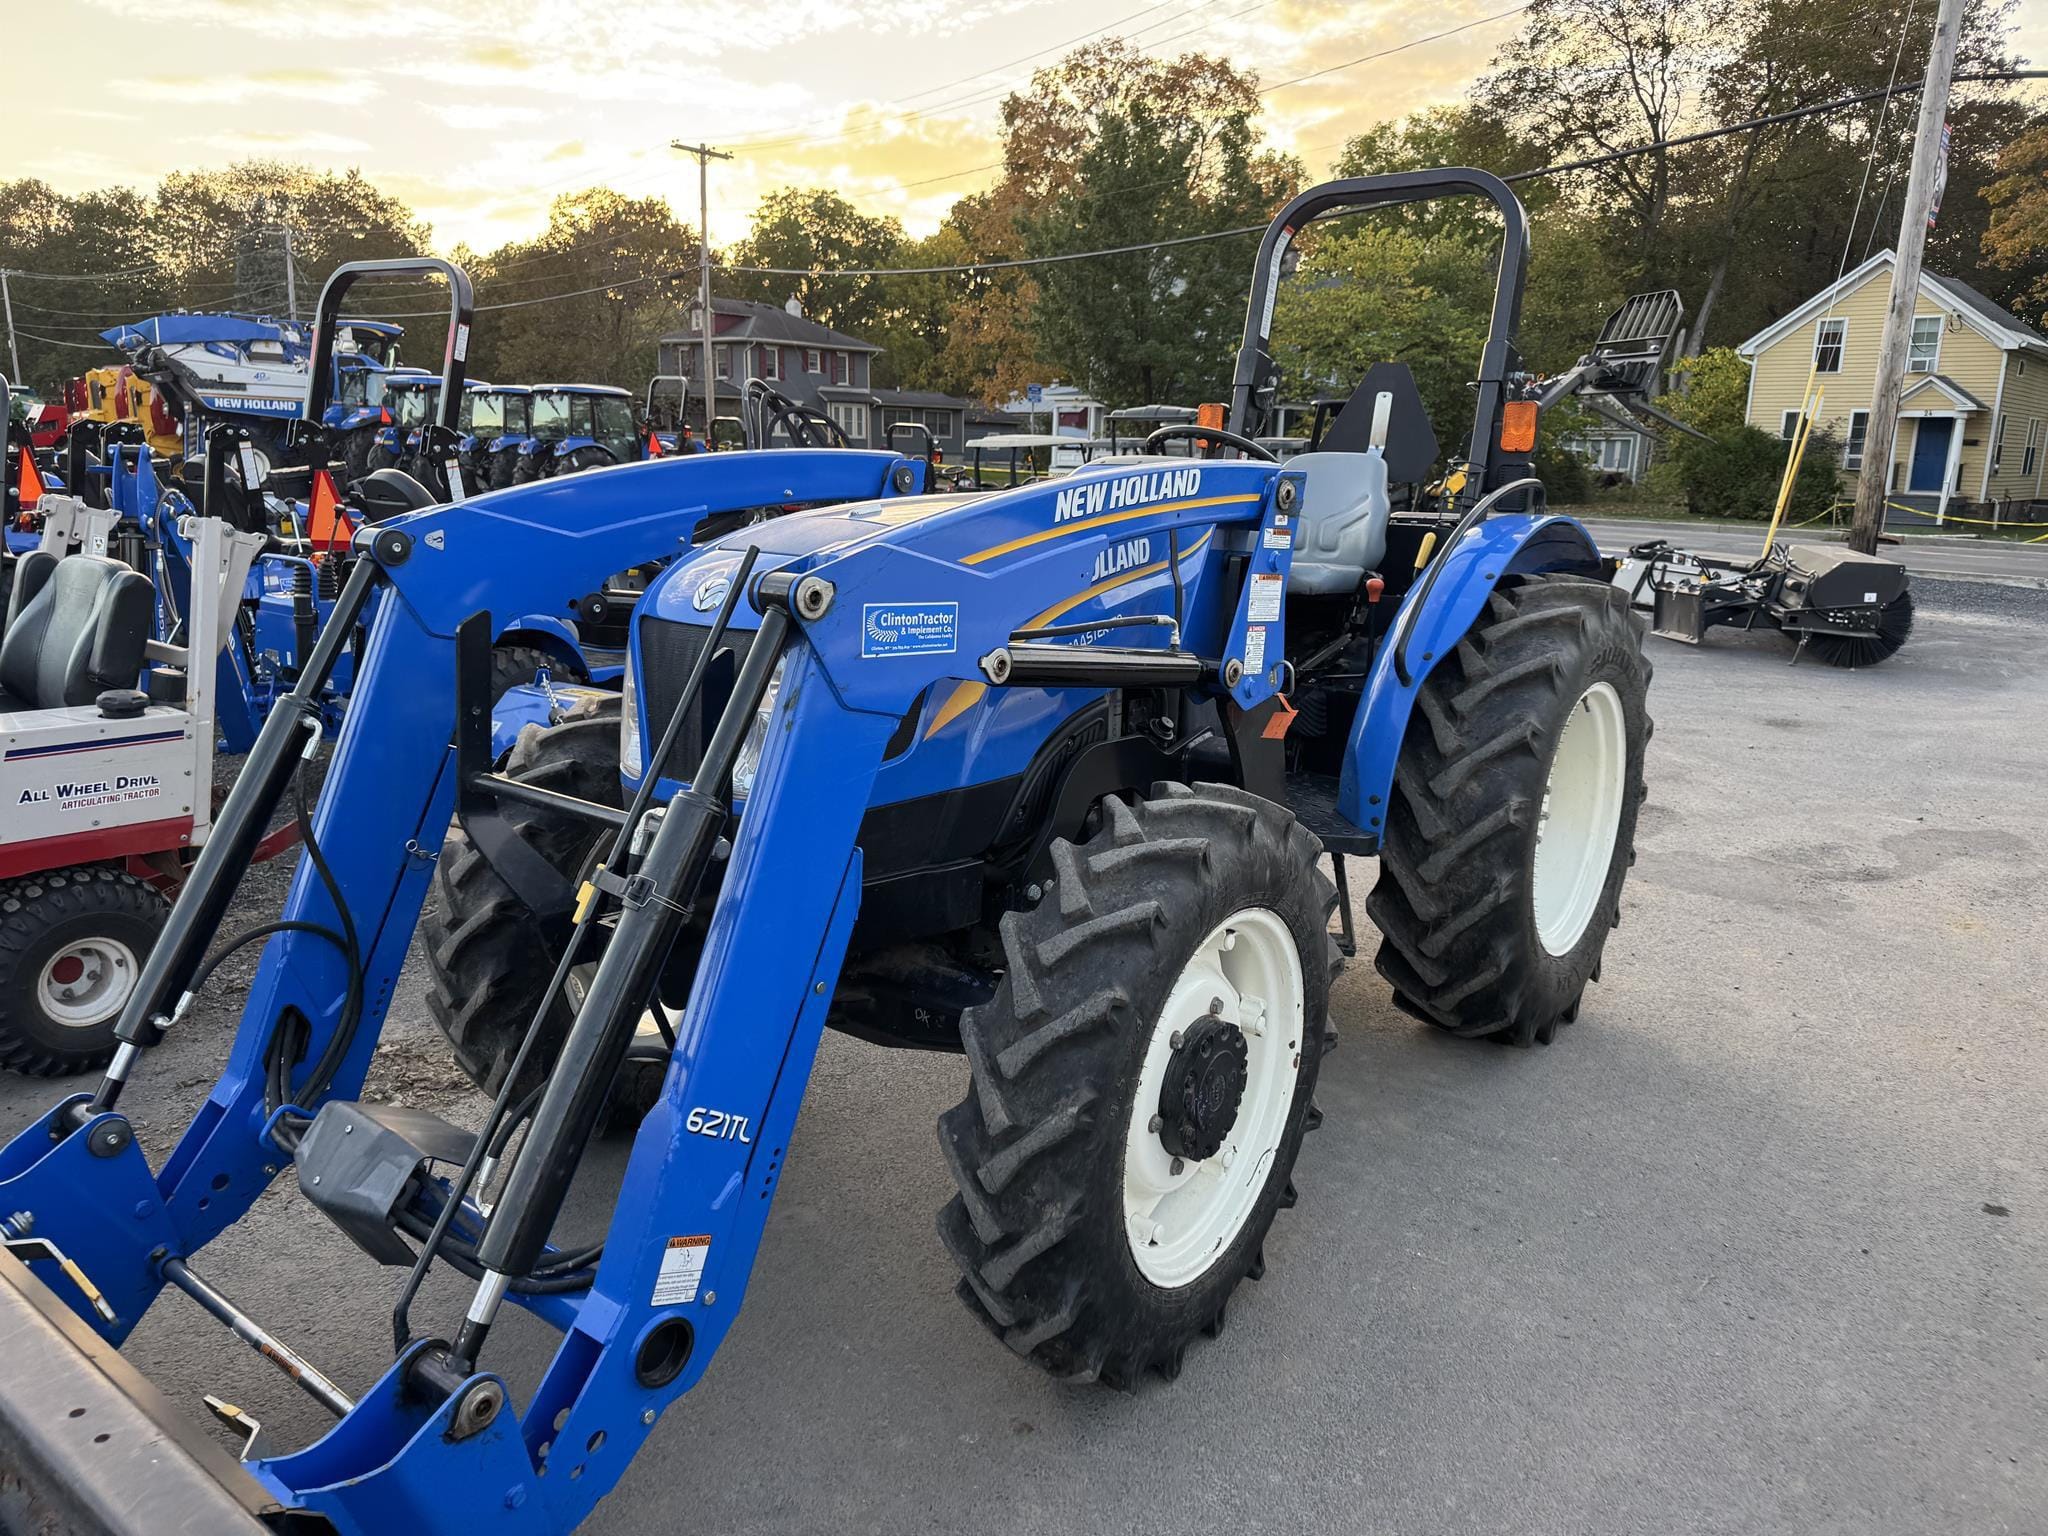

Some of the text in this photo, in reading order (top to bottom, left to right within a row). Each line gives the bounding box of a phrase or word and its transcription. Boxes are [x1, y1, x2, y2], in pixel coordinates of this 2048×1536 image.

[214, 398, 297, 411] NEW HOLLAND
[1054, 468, 1201, 523] NEW HOLLAND
[880, 612, 954, 627] ClintonTractor
[900, 625, 954, 637] & Implement Co.
[18, 775, 159, 804] ALL WHEEL DRIVE
[61, 788, 160, 810] ARTICULATING TRACTOR
[686, 1107, 751, 1143] 621TL
[676, 1236, 710, 1248] WARNING
